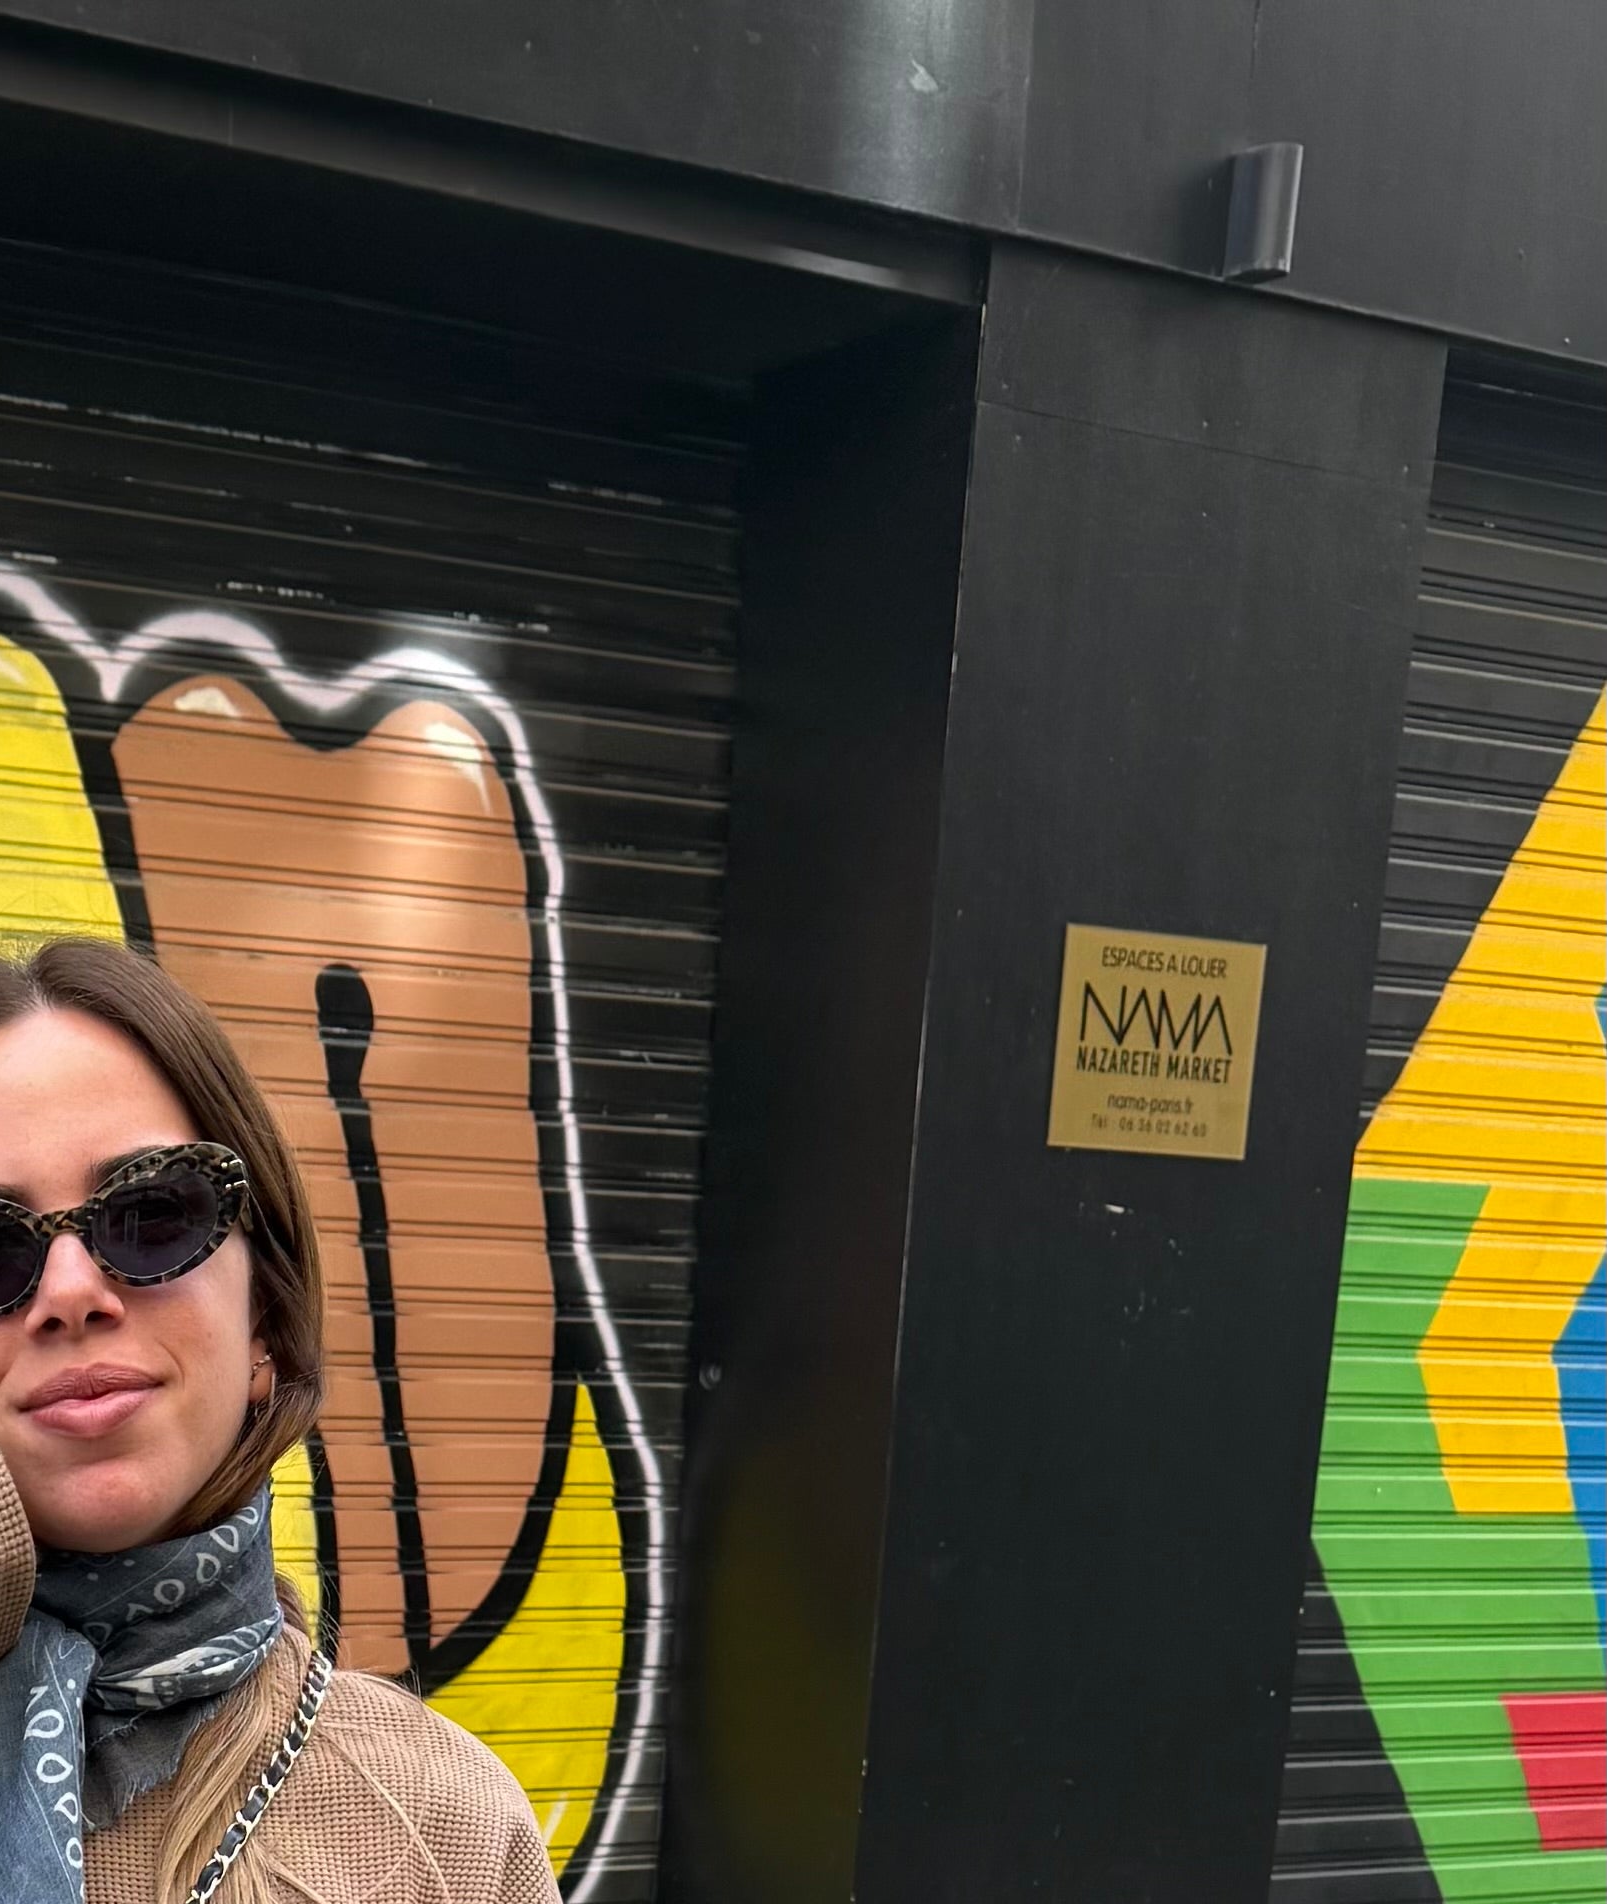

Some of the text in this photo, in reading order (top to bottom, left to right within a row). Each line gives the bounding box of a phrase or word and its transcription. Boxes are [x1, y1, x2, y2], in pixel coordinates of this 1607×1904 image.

[1102, 946, 1228, 979] ESPACES A LOUER
[1080, 981, 1233, 1056] NAMA
[1076, 1046, 1233, 1084] NAZARETH MARKET
